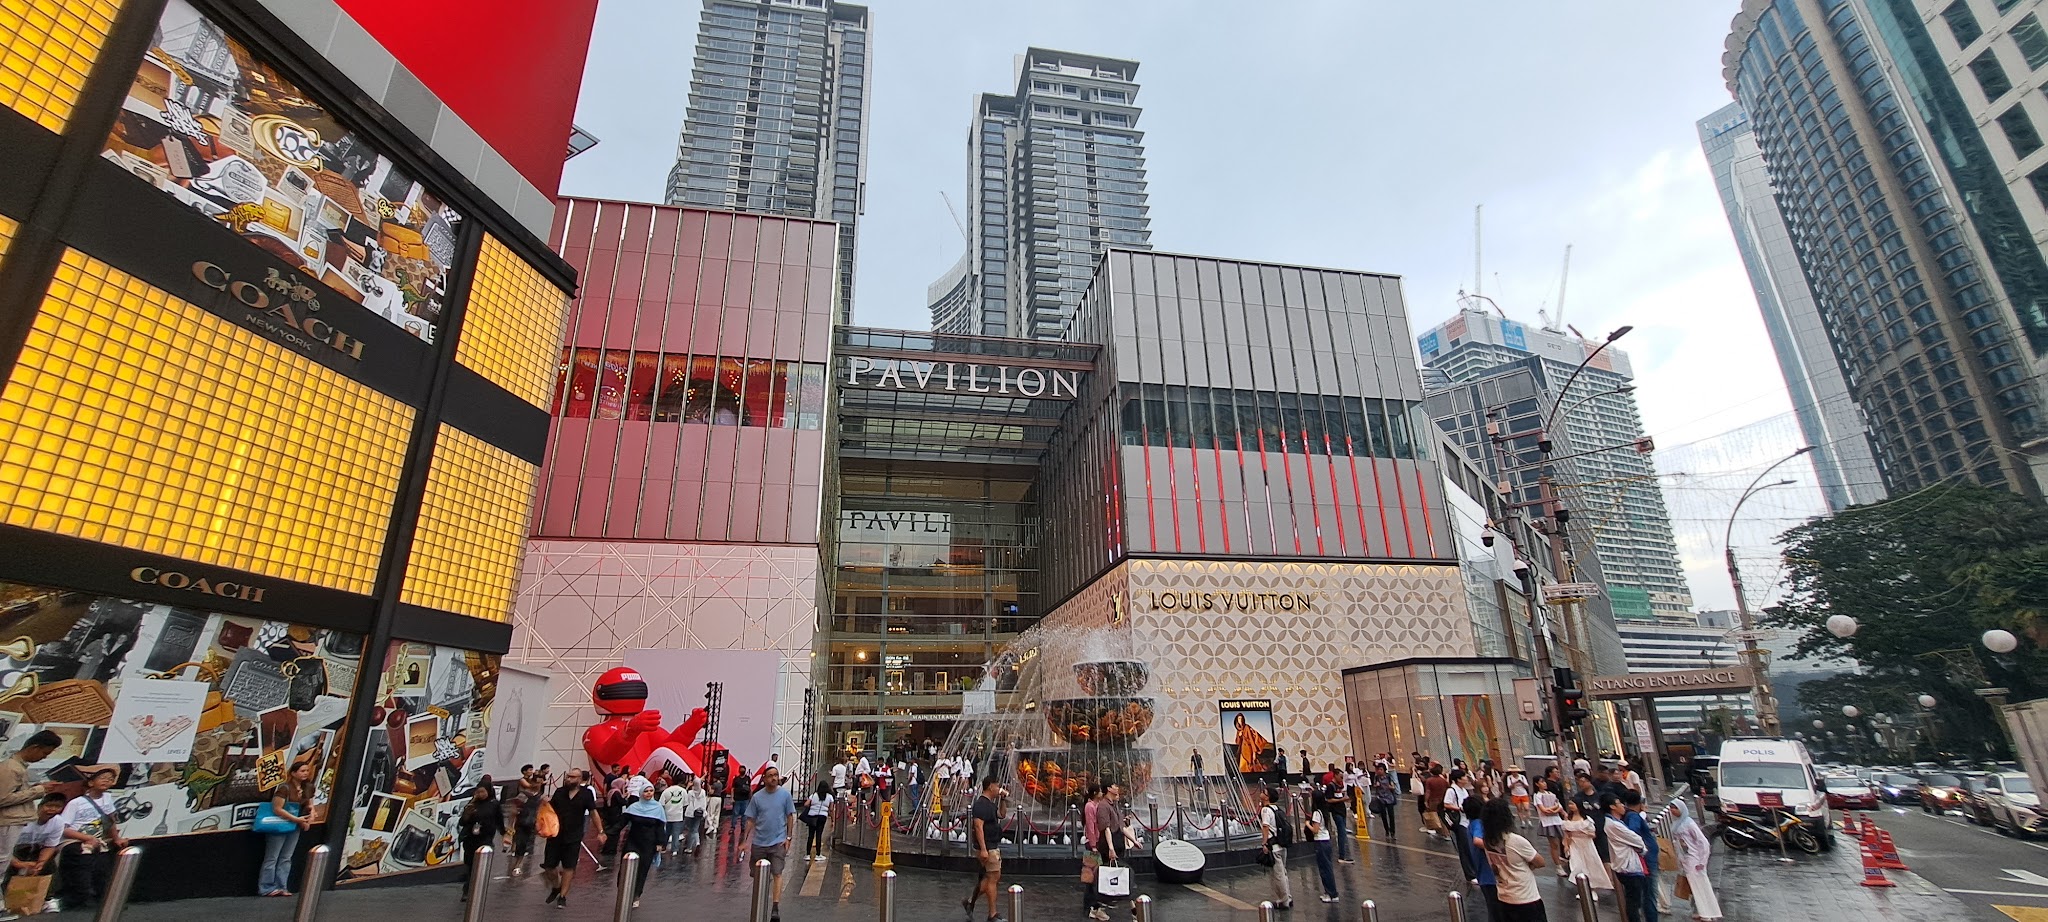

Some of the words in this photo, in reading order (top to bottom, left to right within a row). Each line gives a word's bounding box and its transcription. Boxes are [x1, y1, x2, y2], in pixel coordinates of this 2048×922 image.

[192, 260, 366, 361] COACH
[246, 313, 277, 334] NEW
[279, 329, 313, 351] YORK
[847, 356, 1079, 398] PAVILION
[849, 511, 950, 533] PAVILI
[130, 566, 266, 603] COACH
[1150, 592, 1213, 611] LOUIS
[1221, 593, 1311, 611] VUITTON
[1588, 677, 1645, 690] INTANG
[1649, 671, 1736, 687] ENTRANCE
